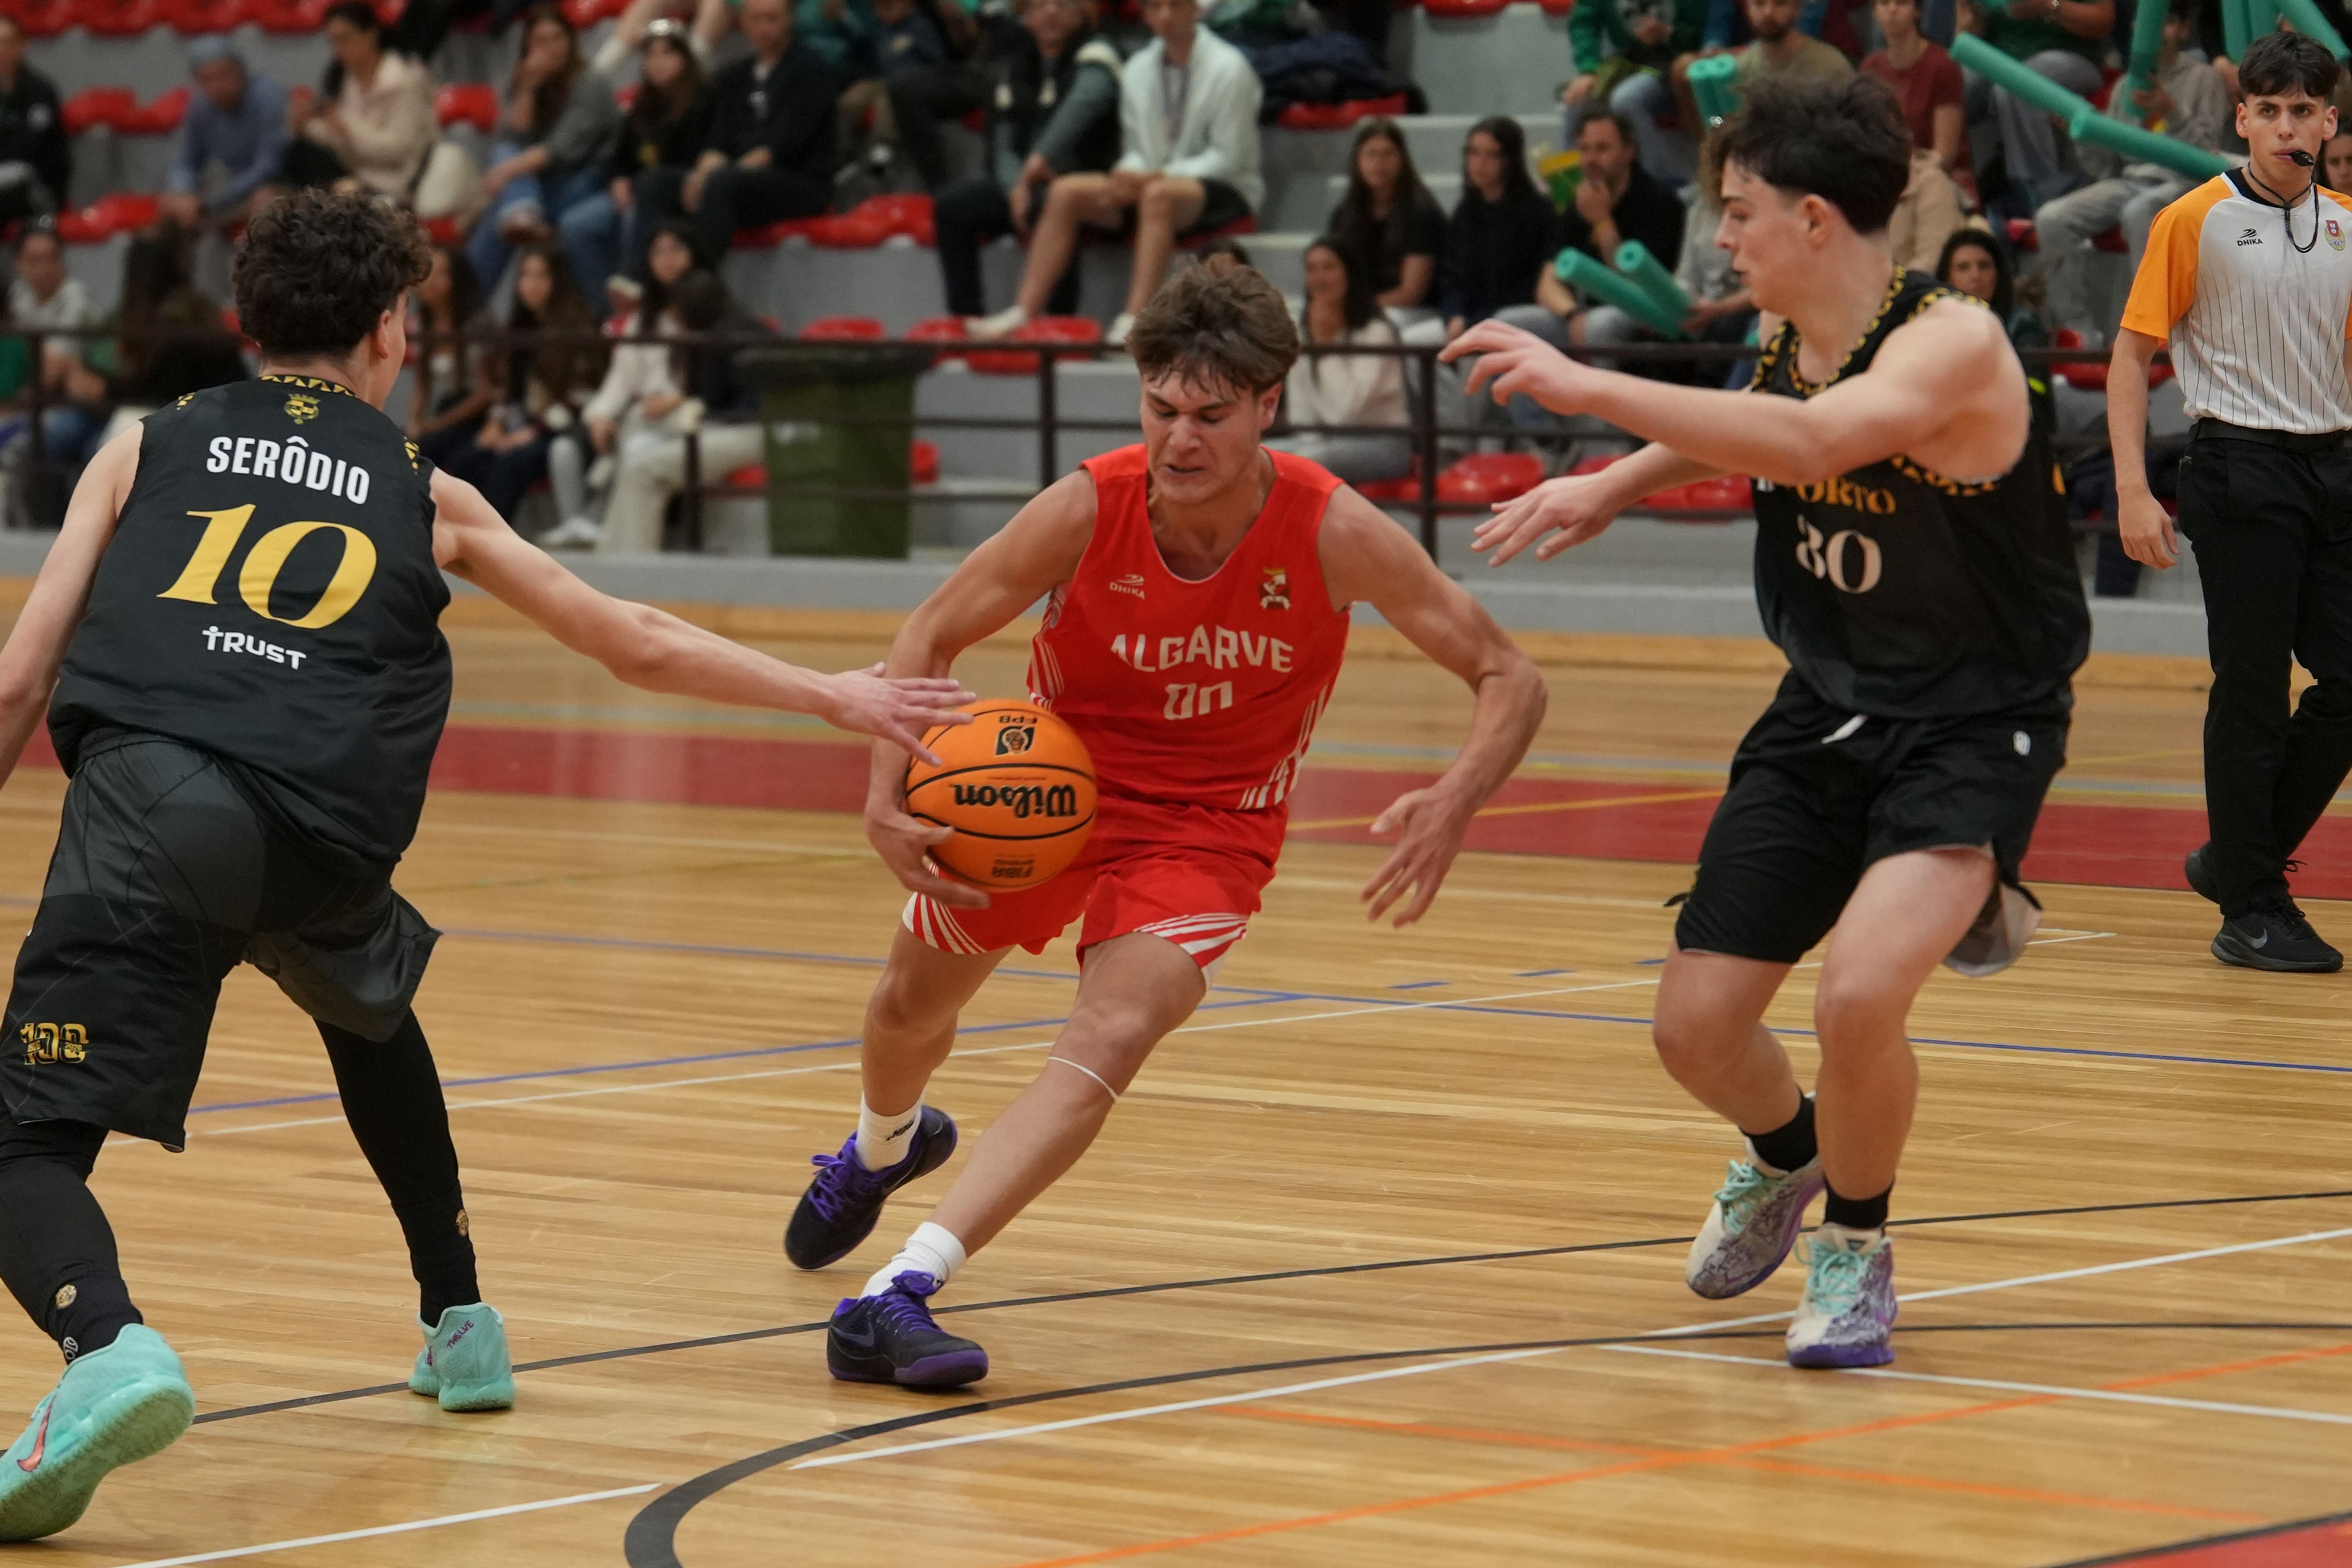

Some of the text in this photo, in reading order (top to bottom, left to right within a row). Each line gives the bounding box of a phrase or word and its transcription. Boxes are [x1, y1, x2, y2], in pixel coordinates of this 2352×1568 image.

[207, 436, 370, 505] SERÔDIO
[156, 504, 377, 629] 10
[203, 626, 307, 669] TRUST
[1110, 625, 1294, 672] ALGARVE
[954, 784, 1076, 818] Wilson
